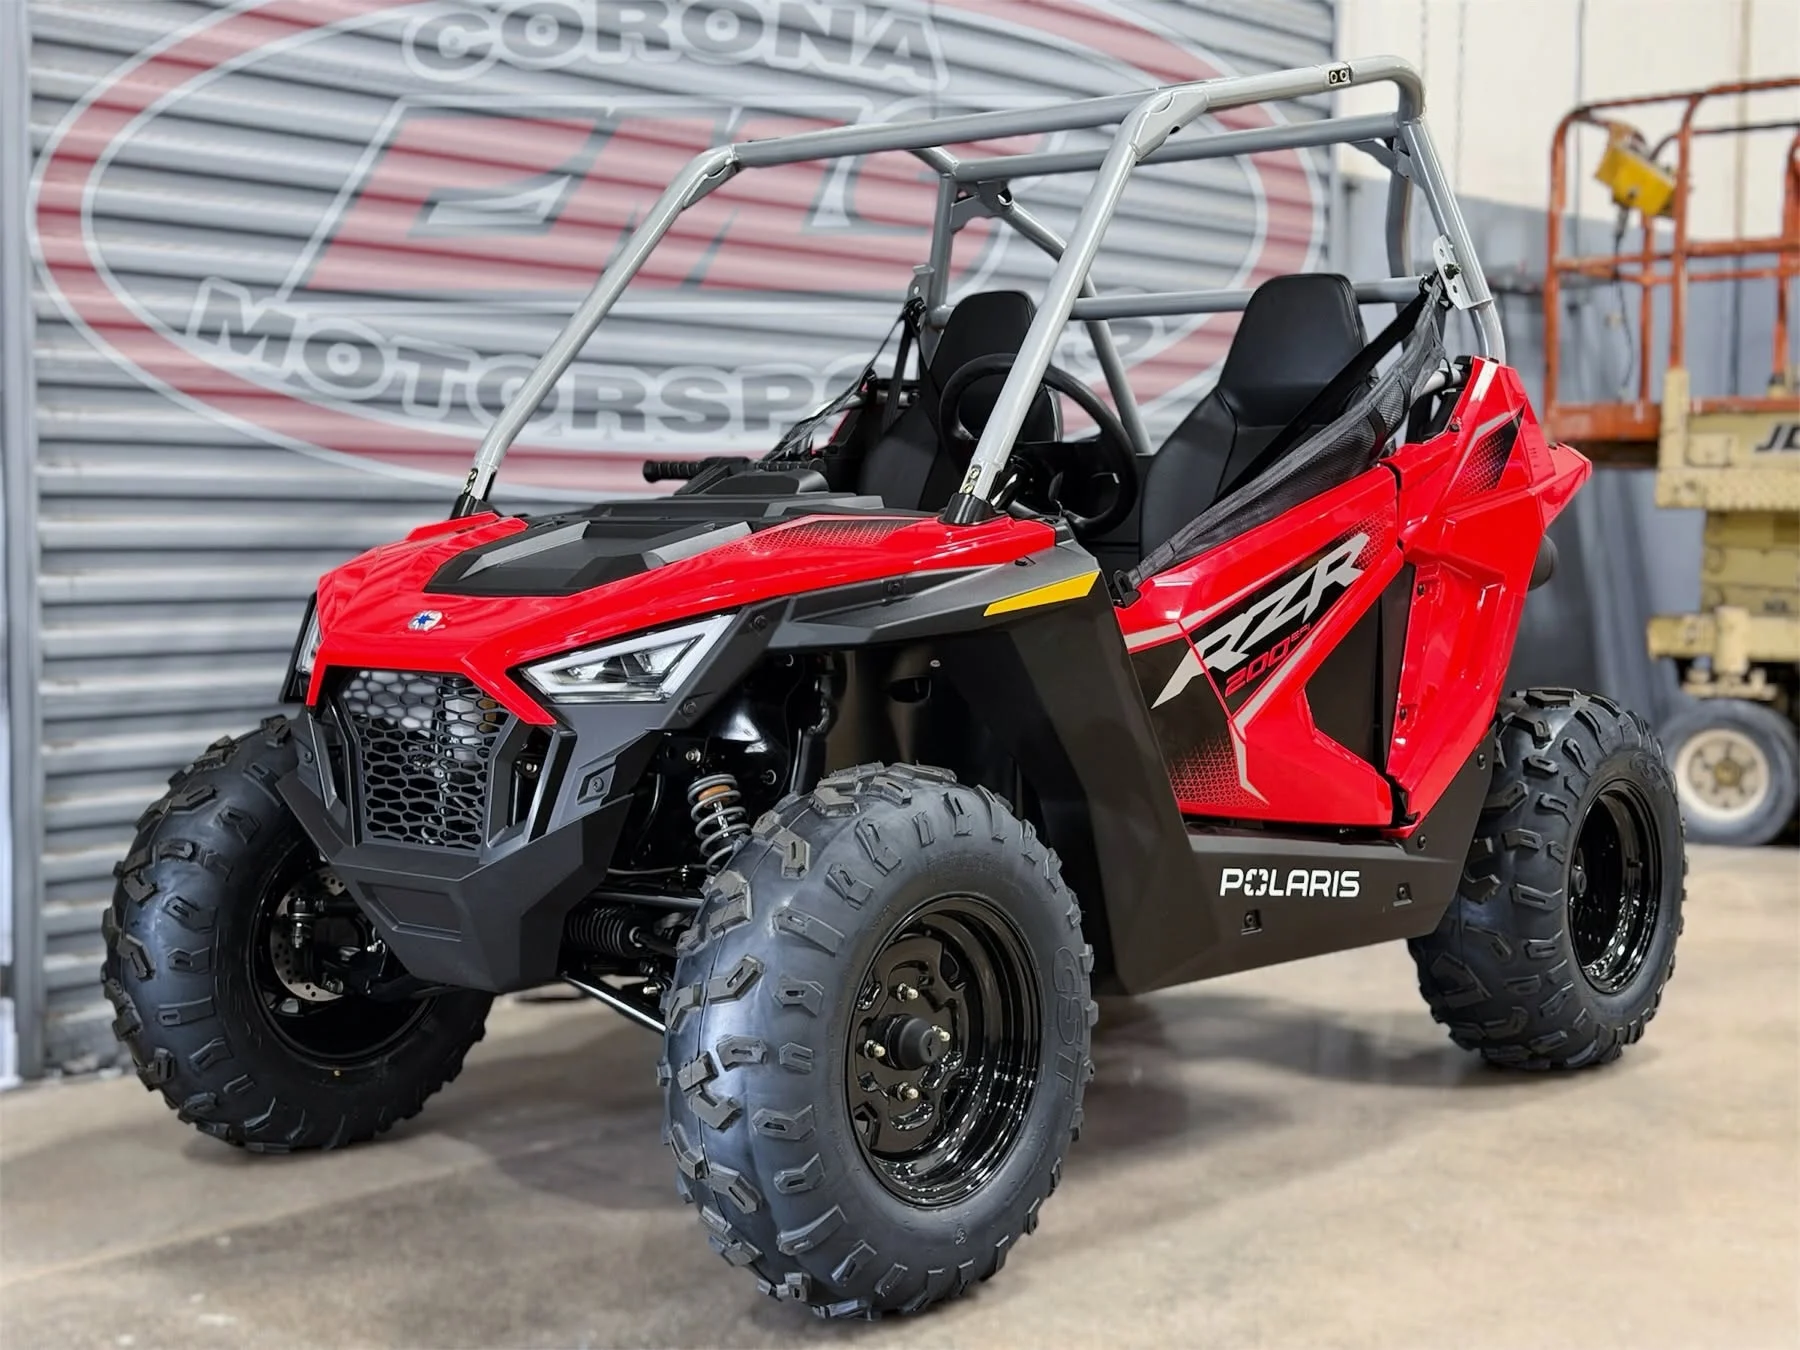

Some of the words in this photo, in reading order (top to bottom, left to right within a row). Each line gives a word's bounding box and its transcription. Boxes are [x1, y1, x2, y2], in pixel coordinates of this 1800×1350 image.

[402, 0, 948, 90] CORONA
[1151, 532, 1371, 709] RZR
[1225, 636, 1291, 697] 200
[1219, 868, 1360, 898] POLARIS
